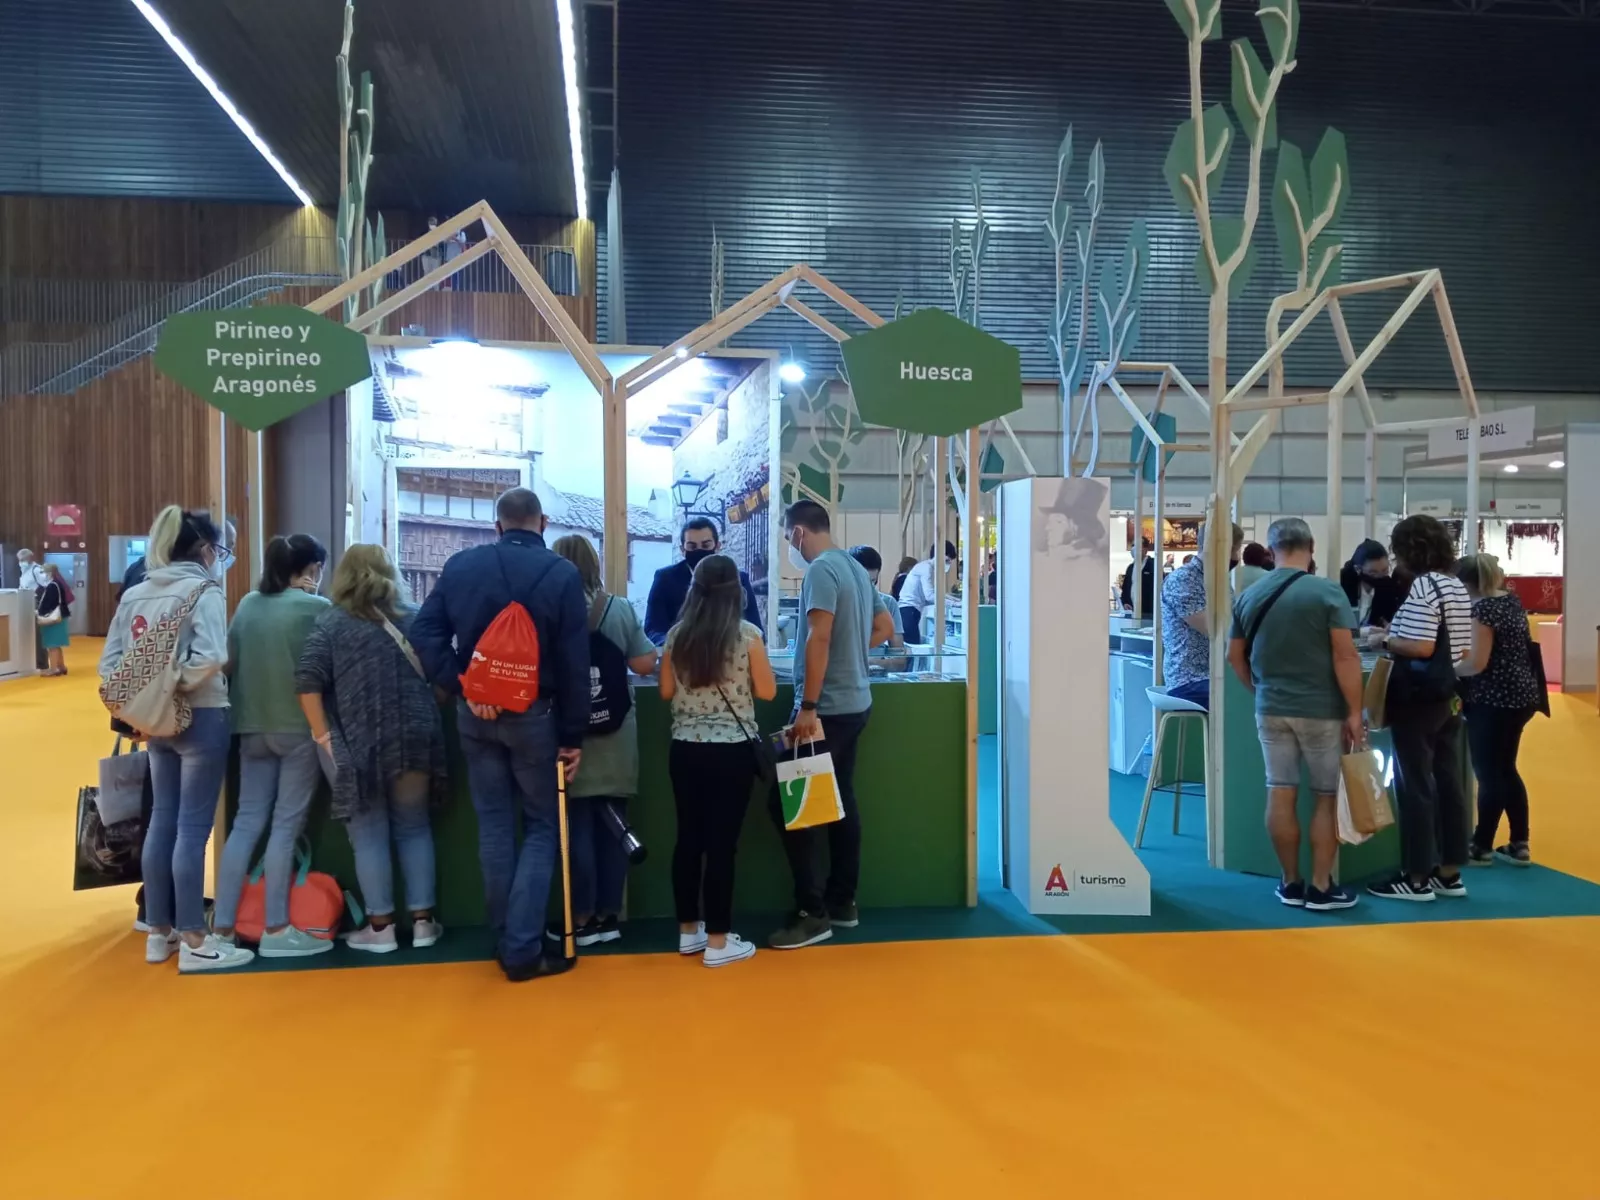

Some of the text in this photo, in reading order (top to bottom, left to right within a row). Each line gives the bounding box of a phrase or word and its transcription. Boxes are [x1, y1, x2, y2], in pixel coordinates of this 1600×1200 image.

[215, 320, 311, 344] Pirineo y
[206, 347, 322, 371] Prepirineo
[900, 361, 973, 382] Huesca
[212, 373, 317, 398] Aragonés
[492, 659, 502, 667] EN
[1080, 875, 1126, 884] turismo
